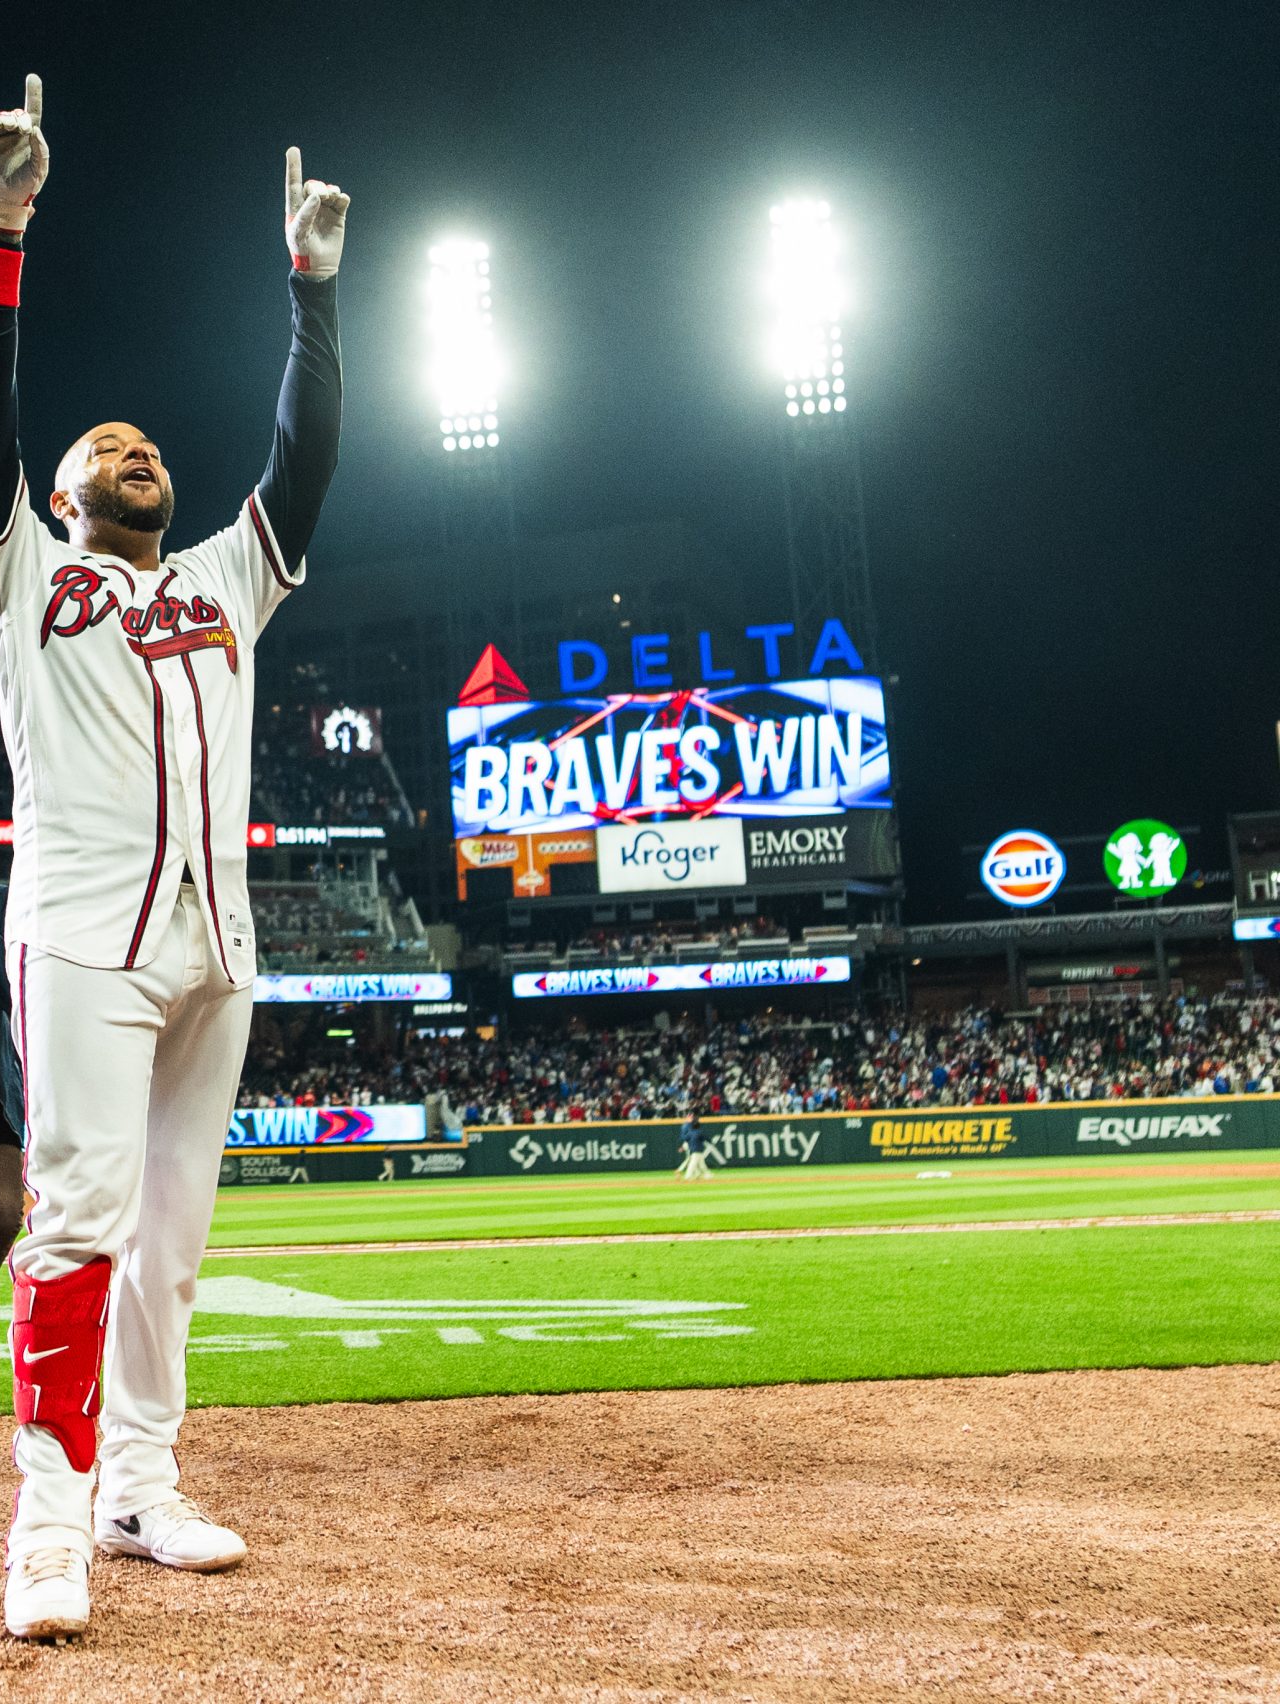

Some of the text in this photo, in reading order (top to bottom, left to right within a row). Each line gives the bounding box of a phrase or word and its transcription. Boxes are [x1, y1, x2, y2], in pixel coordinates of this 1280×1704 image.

[558, 618, 864, 693] DELTA
[463, 712, 862, 822] BRAVES WIN
[750, 826, 848, 856] EMORY
[621, 830, 720, 881] Kroger
[751, 852, 846, 868] HEALTHCARE
[989, 857, 1057, 879] Gulf
[310, 974, 382, 998] BRAVES
[545, 966, 649, 994] BRAVES WIN
[711, 958, 818, 986] BRAVES WIN
[252, 1107, 319, 1144] WIN
[870, 1118, 1013, 1147] QUIKRETE
[1077, 1114, 1223, 1146] EQUIFAX
[241, 1157, 280, 1167] SOUTH
[546, 1140, 647, 1163] Wellstar
[241, 1166, 292, 1177] COLLEGE
